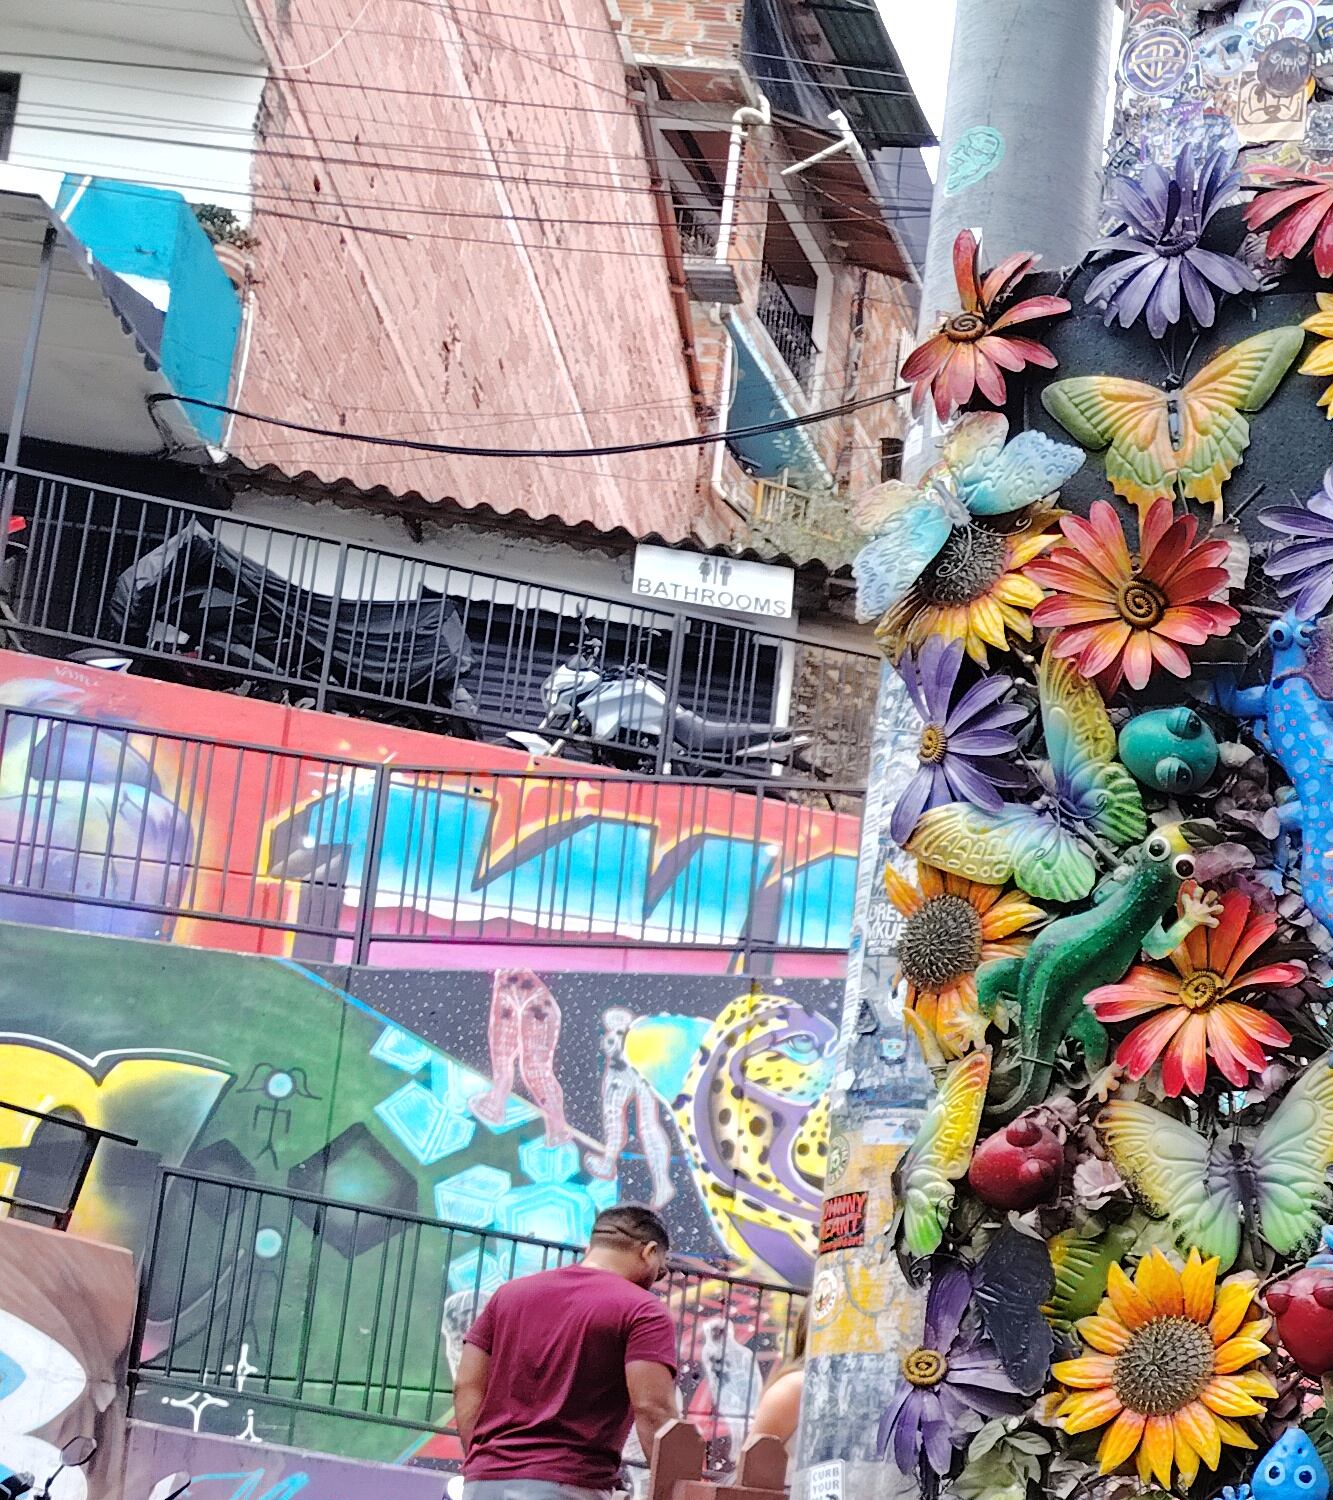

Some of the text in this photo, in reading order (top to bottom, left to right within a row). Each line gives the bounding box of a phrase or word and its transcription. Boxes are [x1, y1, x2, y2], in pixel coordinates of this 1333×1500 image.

[637, 577, 787, 617] BATHROOMS
[812, 1466, 840, 1482] CURB
[812, 1479, 841, 1495] YOUR
